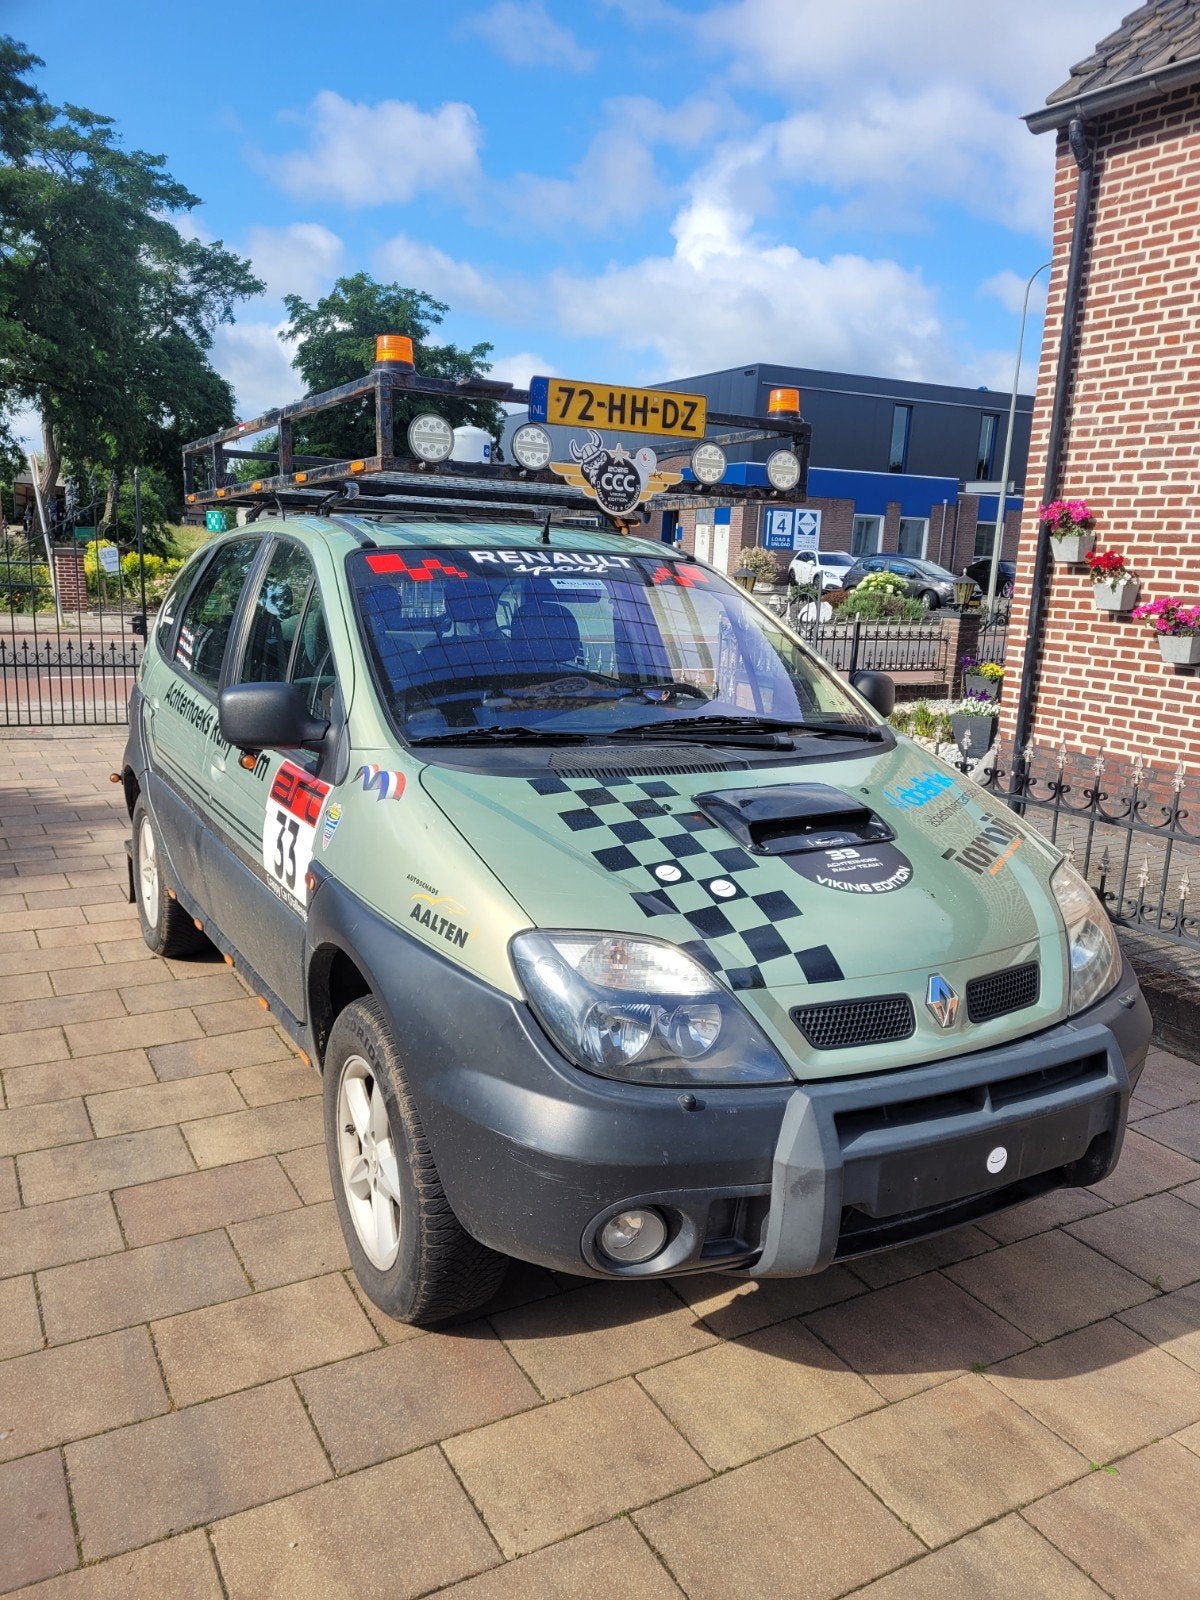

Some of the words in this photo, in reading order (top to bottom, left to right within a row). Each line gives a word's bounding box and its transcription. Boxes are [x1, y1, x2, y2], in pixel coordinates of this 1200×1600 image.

[532, 405, 545, 416] NL
[557, 386, 699, 432] 72-HH-DZ
[601, 472, 636, 492] CCC
[777, 518, 787, 533] 4
[468, 550, 632, 569] RENAULT
[513, 562, 609, 576] sport
[164, 680, 214, 736] Achterhoeks
[274, 809, 300, 891] 33
[825, 848, 861, 861] 33
[406, 873, 440, 896] AUTOSCHADE
[816, 874, 874, 893] VIKING
[873, 865, 911, 892] EDITION
[409, 903, 470, 949] AALTEN
